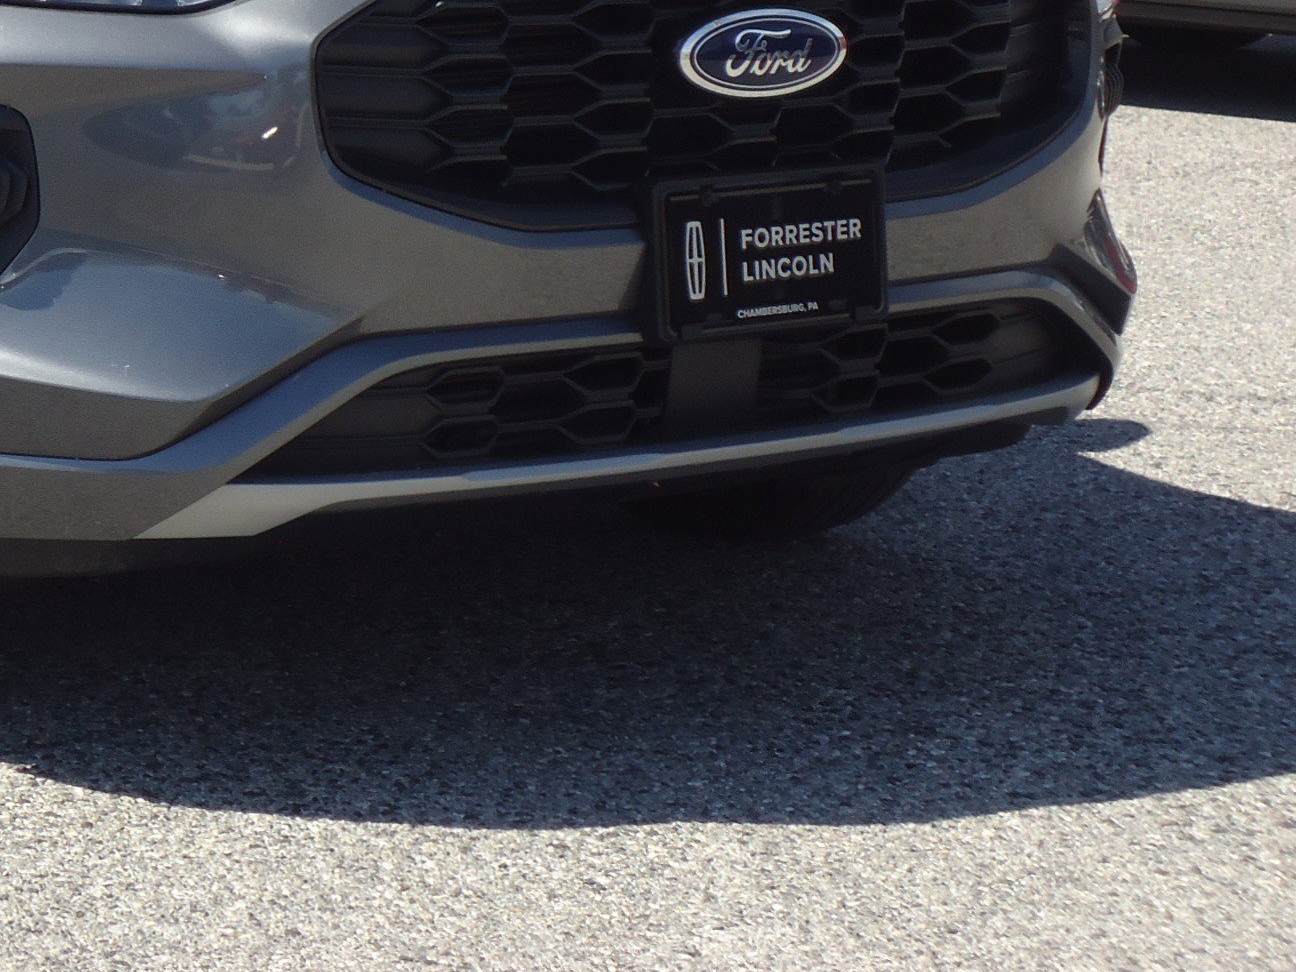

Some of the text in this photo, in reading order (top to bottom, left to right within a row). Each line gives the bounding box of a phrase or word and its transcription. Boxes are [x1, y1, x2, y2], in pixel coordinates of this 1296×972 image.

[725, 28, 813, 78] Ford
[740, 218, 862, 250] FORRESTER
[742, 252, 835, 282] LINCOLN
[736, 301, 819, 319] CHAMBERSBURG, PA
